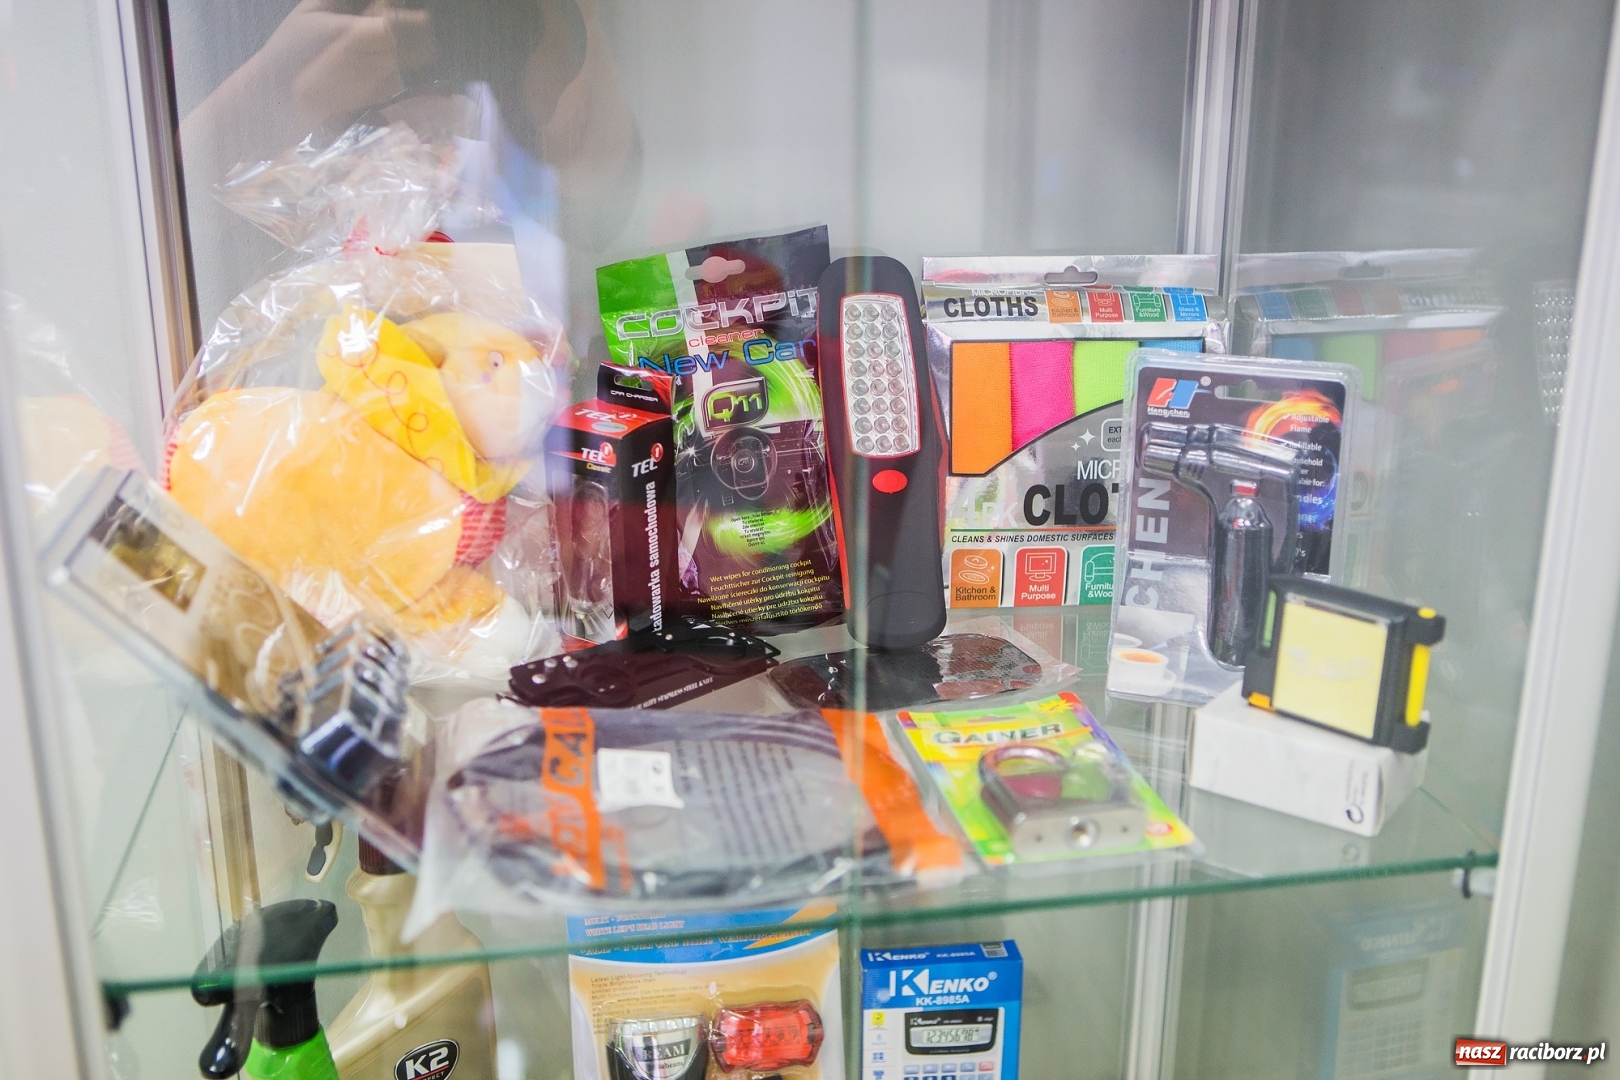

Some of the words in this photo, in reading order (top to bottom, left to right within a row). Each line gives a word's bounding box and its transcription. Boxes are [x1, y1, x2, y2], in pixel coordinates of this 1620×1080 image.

[943, 296, 1039, 318] CLOTHS
[688, 328, 764, 348] cleaner
[638, 350, 729, 376] New
[743, 338, 817, 366] Car
[1291, 413, 1330, 424] Adjustable
[1290, 425, 1312, 433] Flame
[644, 481, 659, 568] samochodowa
[951, 534, 985, 543] CLEANS
[986, 534, 992, 542] &
[995, 534, 1025, 543] SHINES
[1027, 533, 1069, 543] DOMESTIC
[1071, 532, 1114, 541] SURFACES
[710, 575, 723, 583] Wet
[723, 572, 741, 581] wipes
[790, 559, 812, 568] cockpit
[768, 579, 804, 591] konserwacji
[804, 575, 830, 584] cockpitu
[797, 586, 821, 595] kokpitu
[955, 586, 987, 594] Kitchen
[989, 586, 996, 594] &
[1029, 584, 1050, 592] Multi
[766, 603, 777, 611] pre
[800, 594, 823, 603] kokpitu
[955, 593, 996, 601] Bathroom
[1021, 592, 1056, 601] Purpose
[889, 968, 990, 997] KENKO
[405, 1046, 450, 1080] K2
